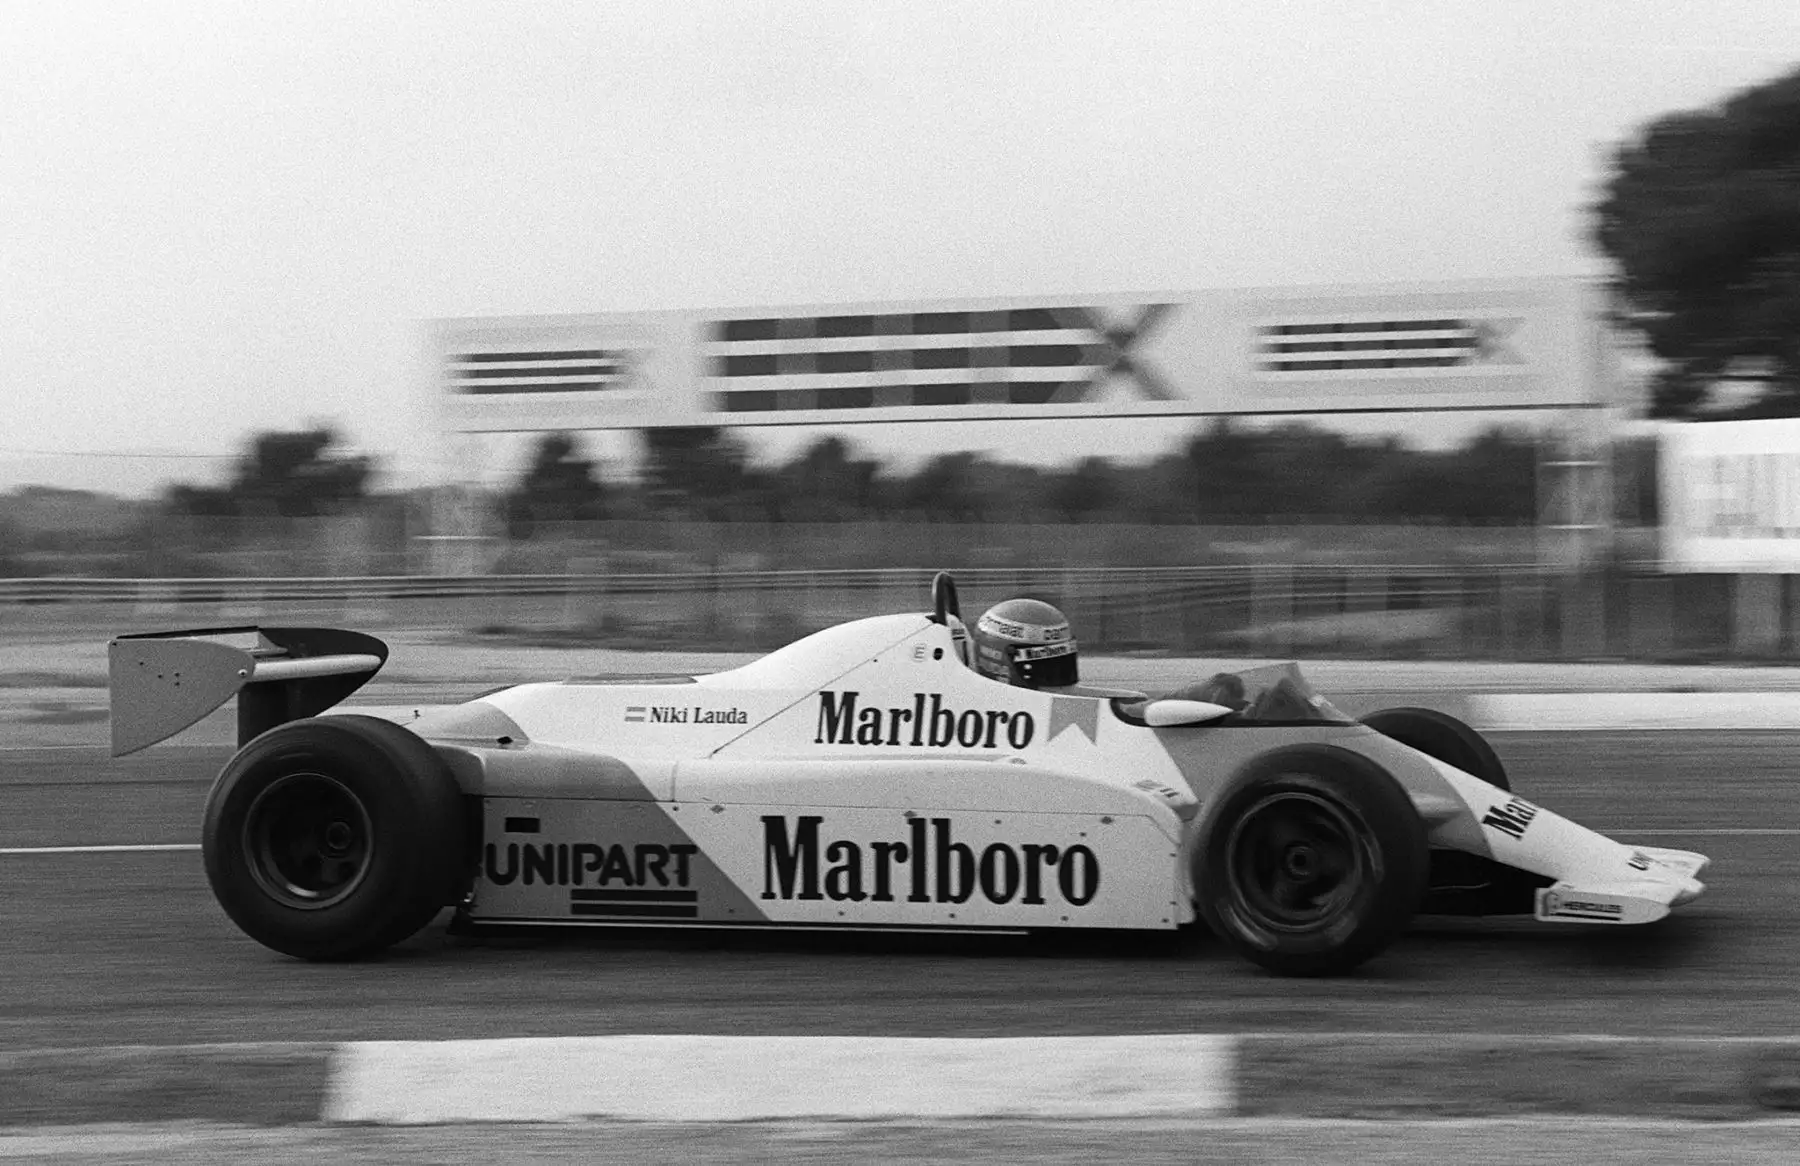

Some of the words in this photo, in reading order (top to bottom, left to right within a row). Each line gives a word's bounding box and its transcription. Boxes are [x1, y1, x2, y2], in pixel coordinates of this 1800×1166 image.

[650, 706, 687, 723] Niki
[693, 706, 748, 724] Lauda
[814, 690, 1035, 750] Marlboro
[485, 843, 698, 887] UNIPART
[760, 815, 1099, 907] Marlboro
